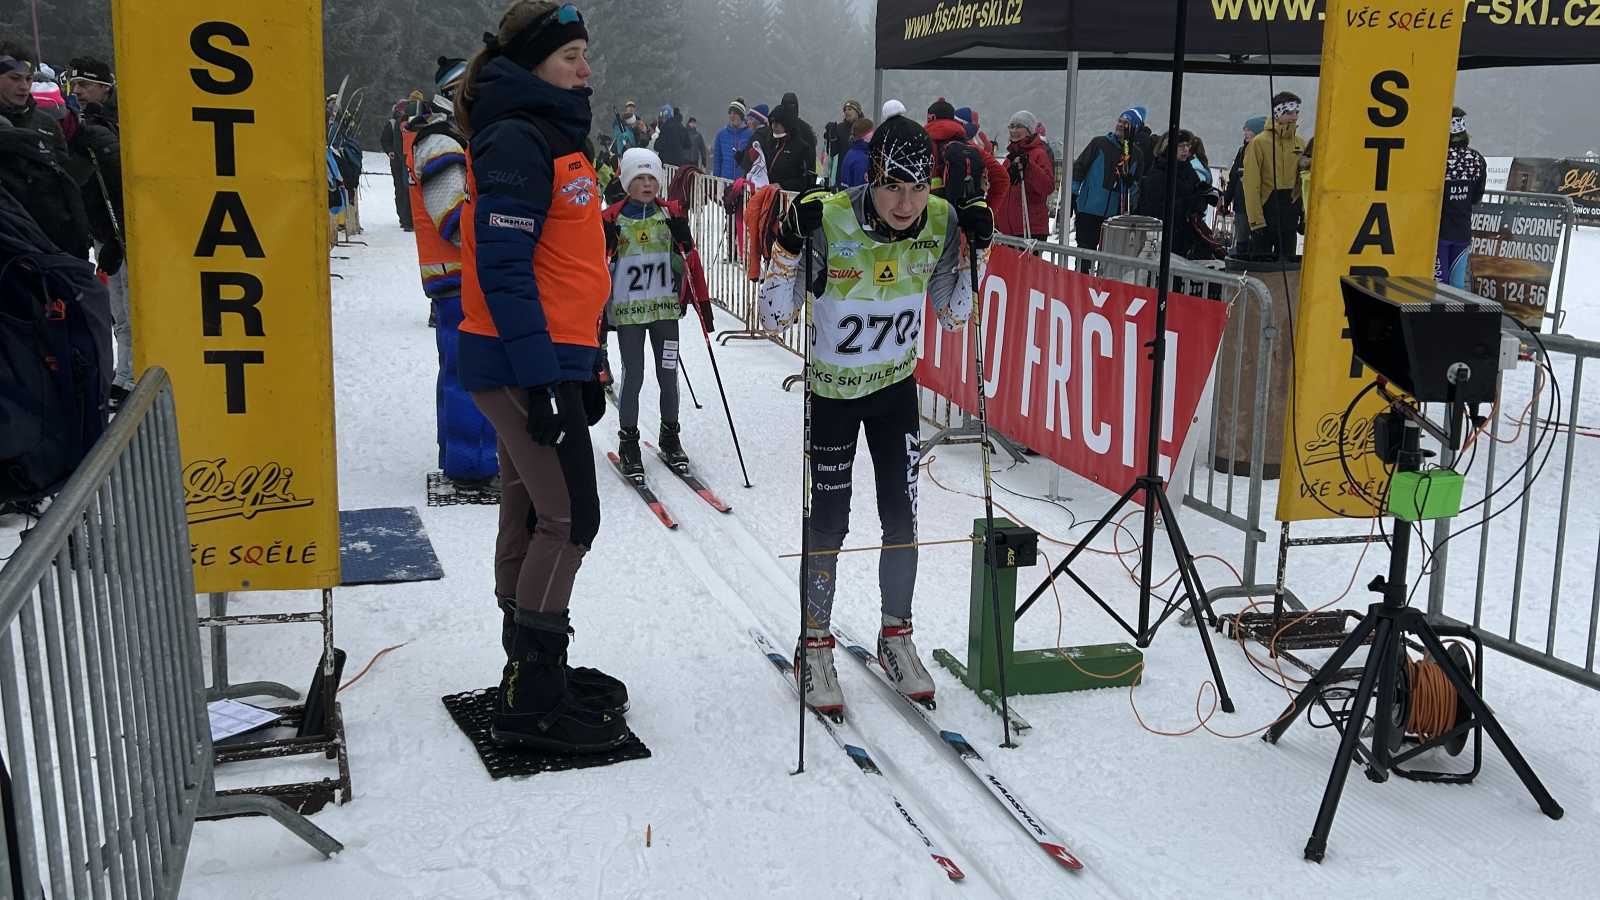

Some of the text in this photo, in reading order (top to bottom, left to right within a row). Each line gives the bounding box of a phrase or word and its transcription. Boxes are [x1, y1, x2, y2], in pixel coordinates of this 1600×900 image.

[1346, 8, 1453, 31] VŠE SQĚLÉ
[189, 21, 266, 415] START
[910, 240, 939, 249] ATEX
[627, 262, 667, 292] 271
[1477, 277, 1497, 299] 736
[1502, 281, 1525, 304] 124
[835, 309, 915, 355] 270
[838, 376, 862, 386] SKI
[1020, 288, 1178, 482] FRČÍ!
[182, 457, 303, 521] Delfi
[1301, 477, 1386, 498] VŠE SQĚL
[228, 540, 317, 566] SQĚLÉ
